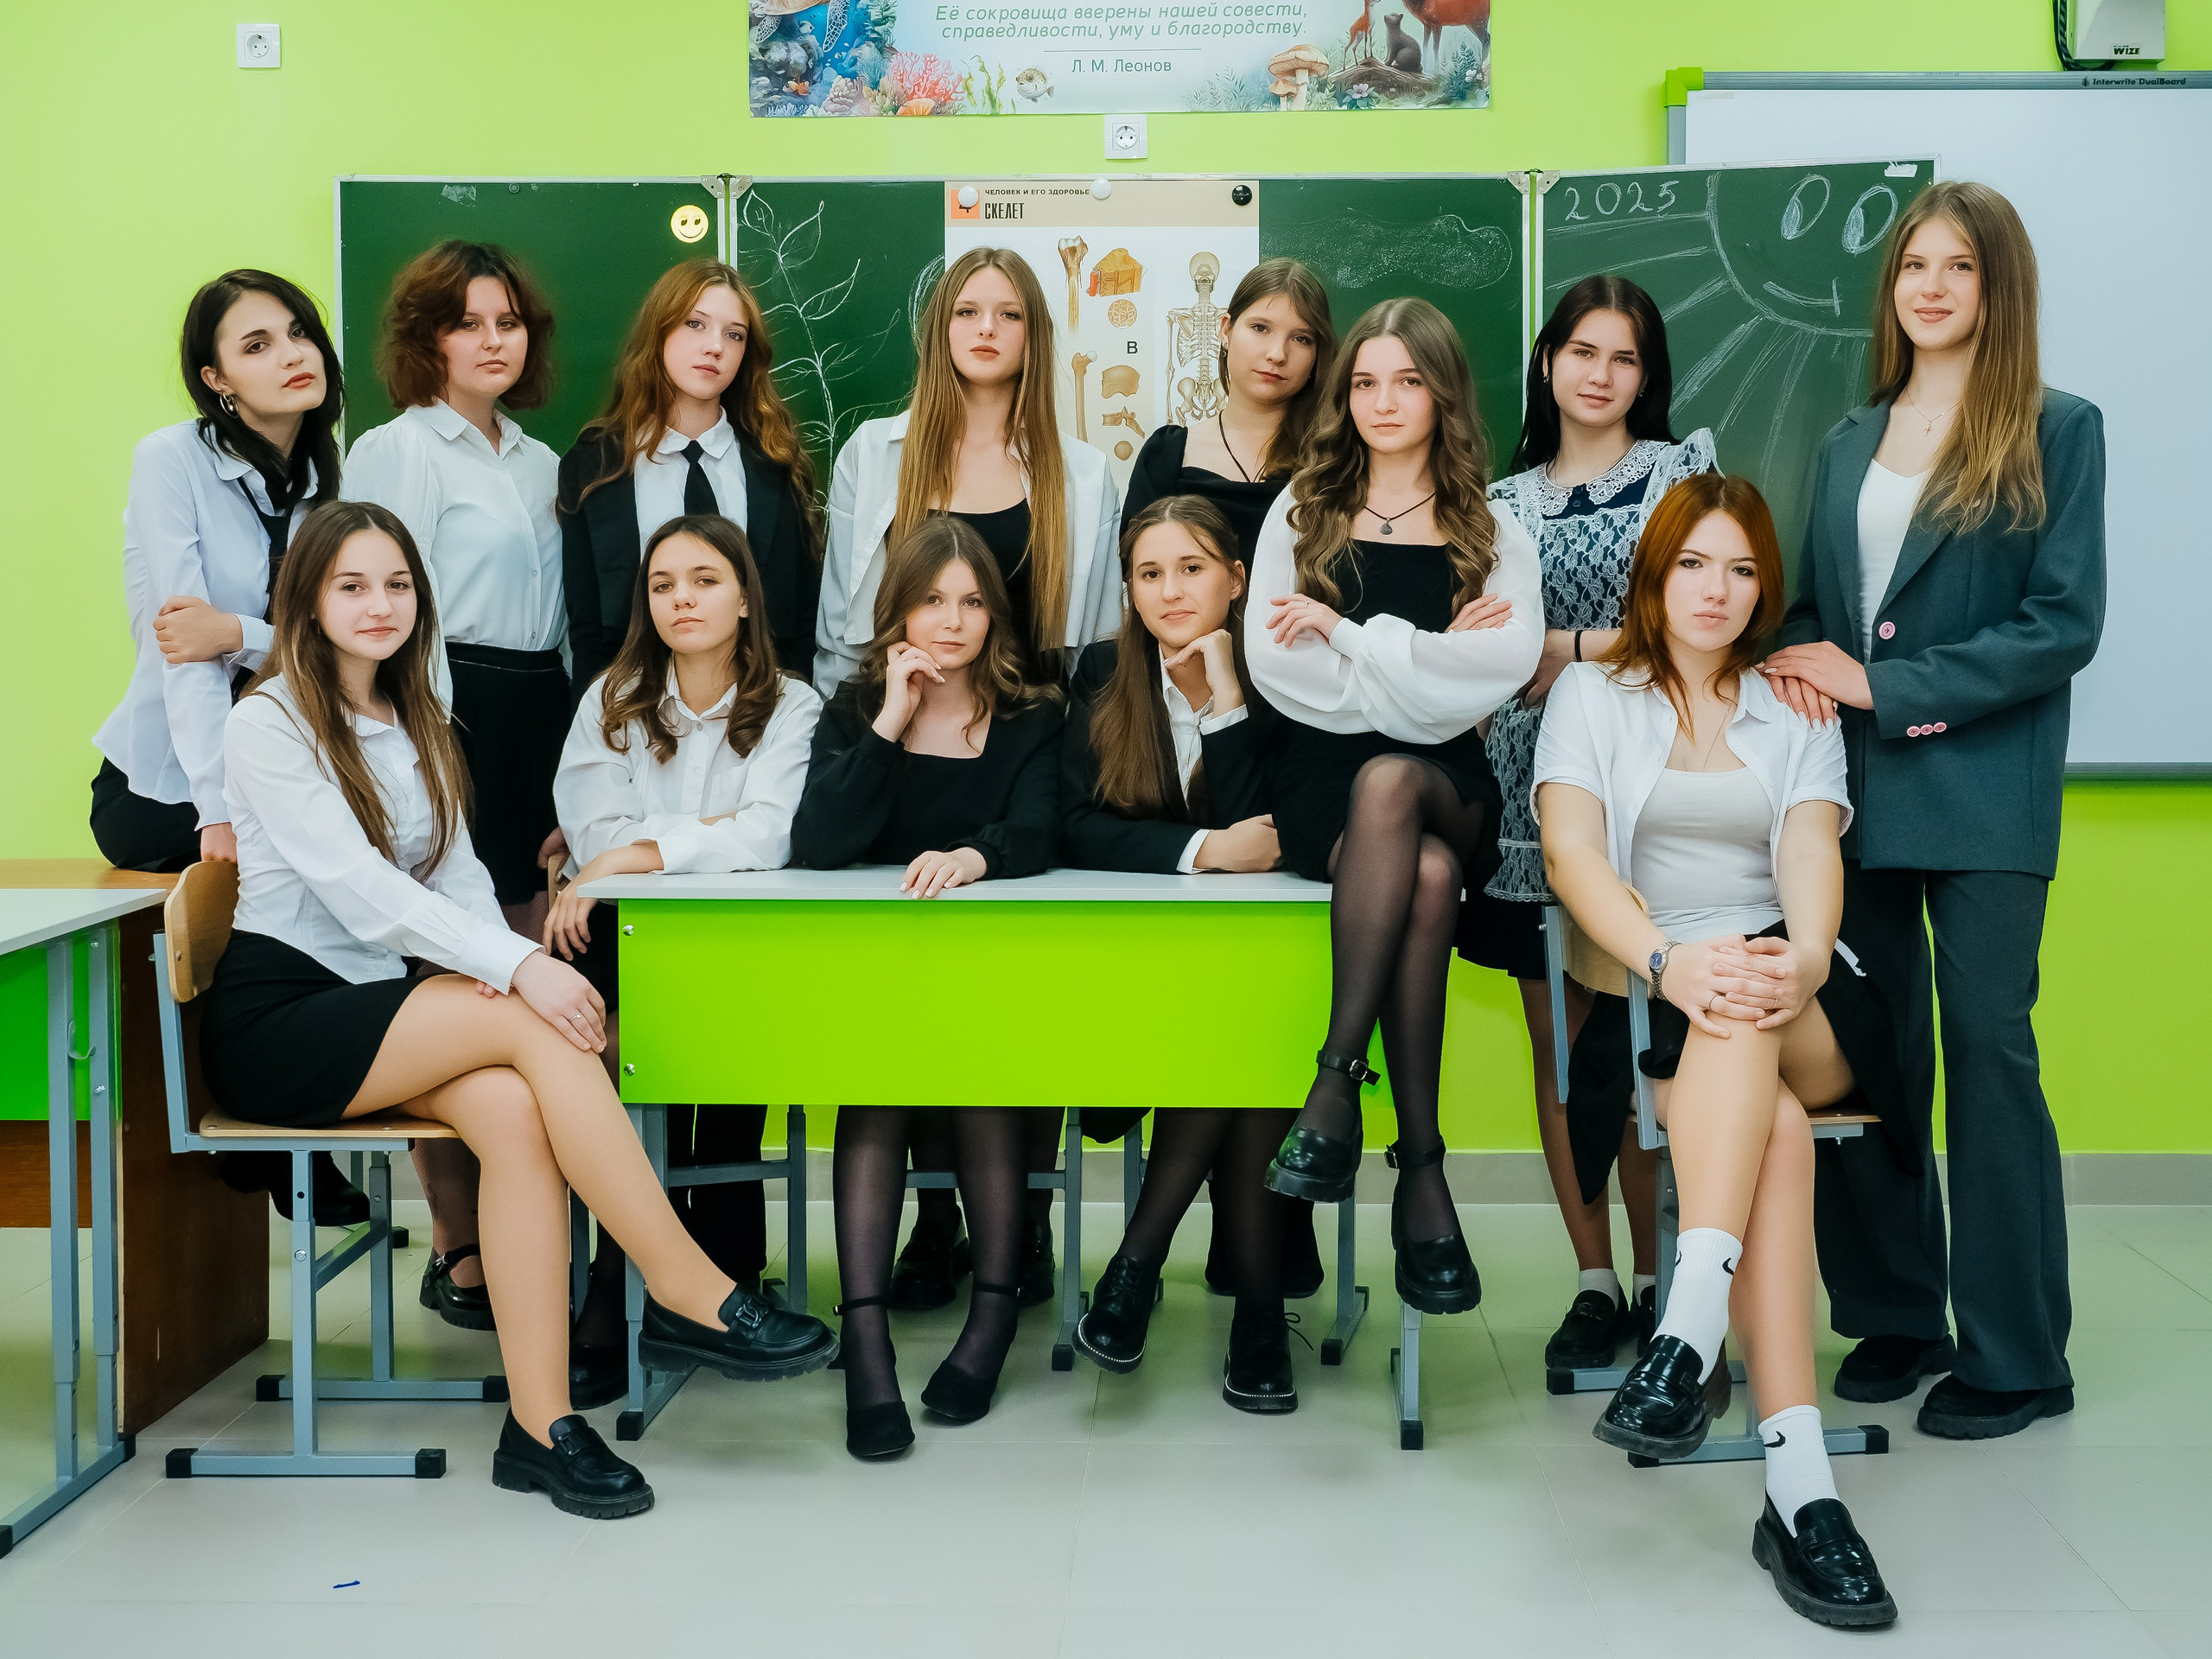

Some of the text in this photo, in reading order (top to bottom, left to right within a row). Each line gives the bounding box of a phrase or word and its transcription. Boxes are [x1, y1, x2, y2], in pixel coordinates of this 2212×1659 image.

[936, 2, 1307, 23] Её сокровища вверены нашей совести,
[942, 19, 1306, 41] справедливости, уму и благородству.
[1071, 59, 1172, 73] Л. М. Леонов
[984, 202, 1025, 219] СКЕЛЕТ
[1564, 180, 1680, 220] 2025
